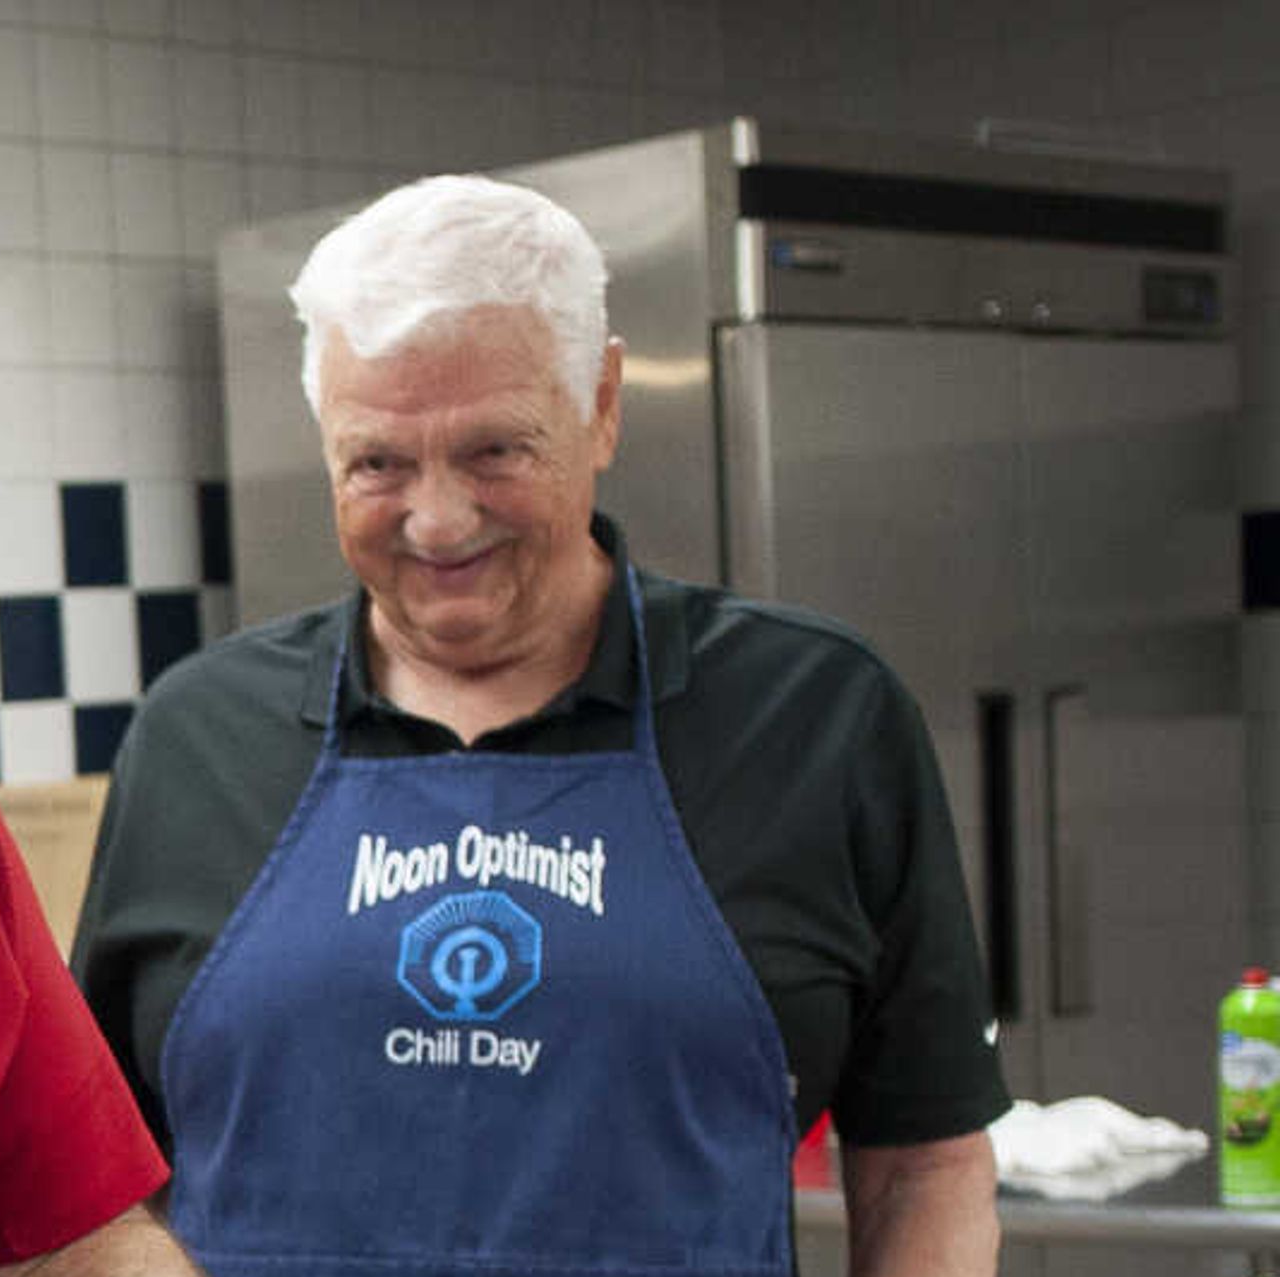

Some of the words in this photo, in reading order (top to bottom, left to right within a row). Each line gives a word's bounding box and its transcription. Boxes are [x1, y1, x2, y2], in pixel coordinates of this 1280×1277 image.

[350, 833, 449, 916] Noon
[456, 824, 606, 916] Optimist
[385, 1027, 461, 1065] Chili
[469, 1029, 542, 1076] Day
